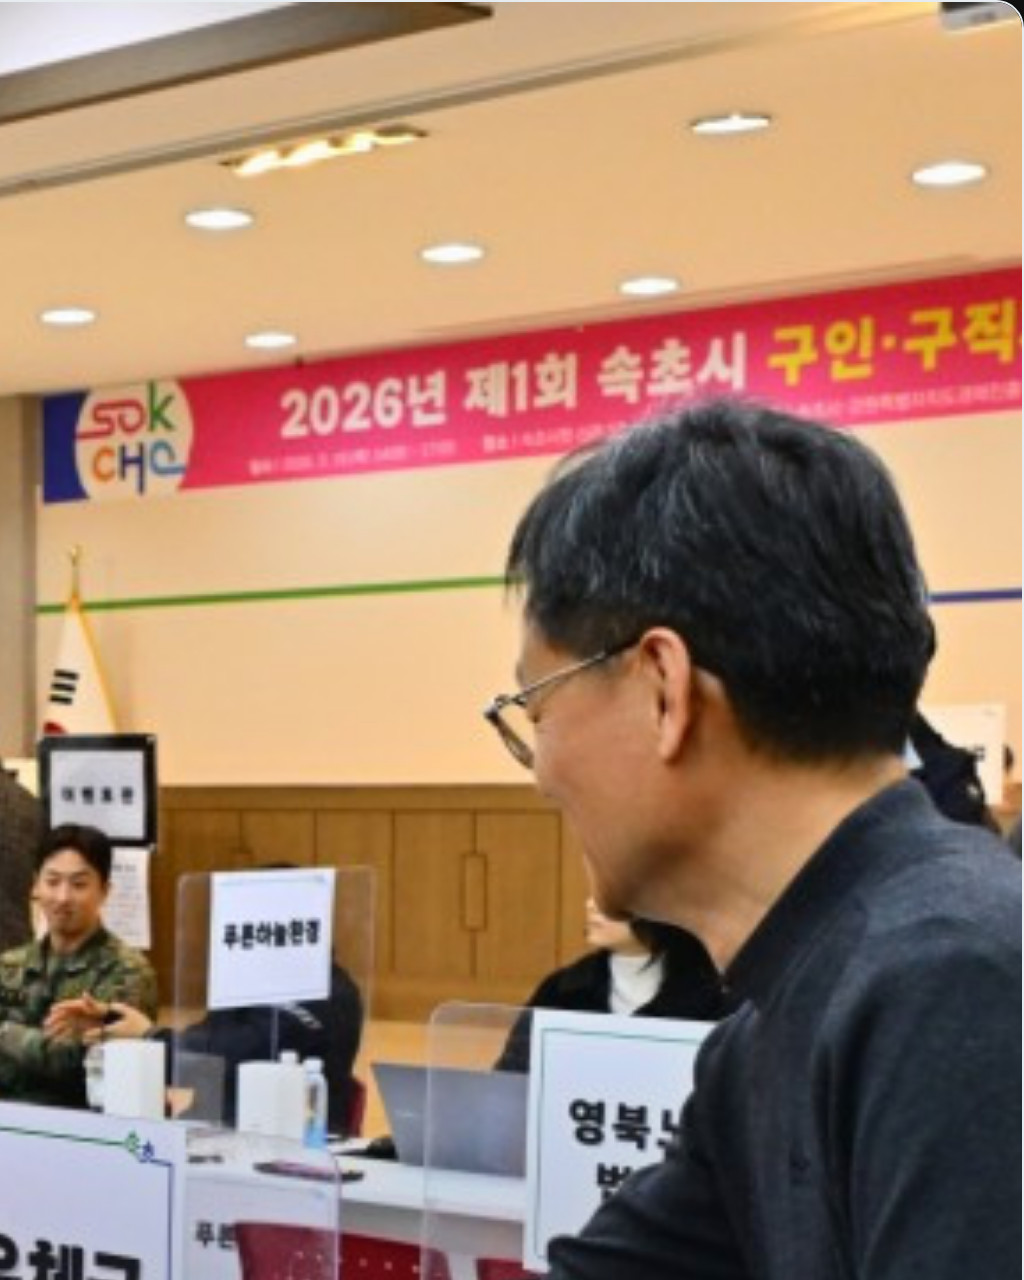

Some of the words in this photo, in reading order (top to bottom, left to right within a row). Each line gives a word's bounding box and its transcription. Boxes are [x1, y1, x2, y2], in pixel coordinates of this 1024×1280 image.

[279, 369, 448, 438] 2026년
[464, 351, 578, 418] 제1회
[596, 330, 748, 404] 속초시
[767, 299, 1023, 386] 구인·구직
[223, 918, 321, 951] 푸른하늘환경
